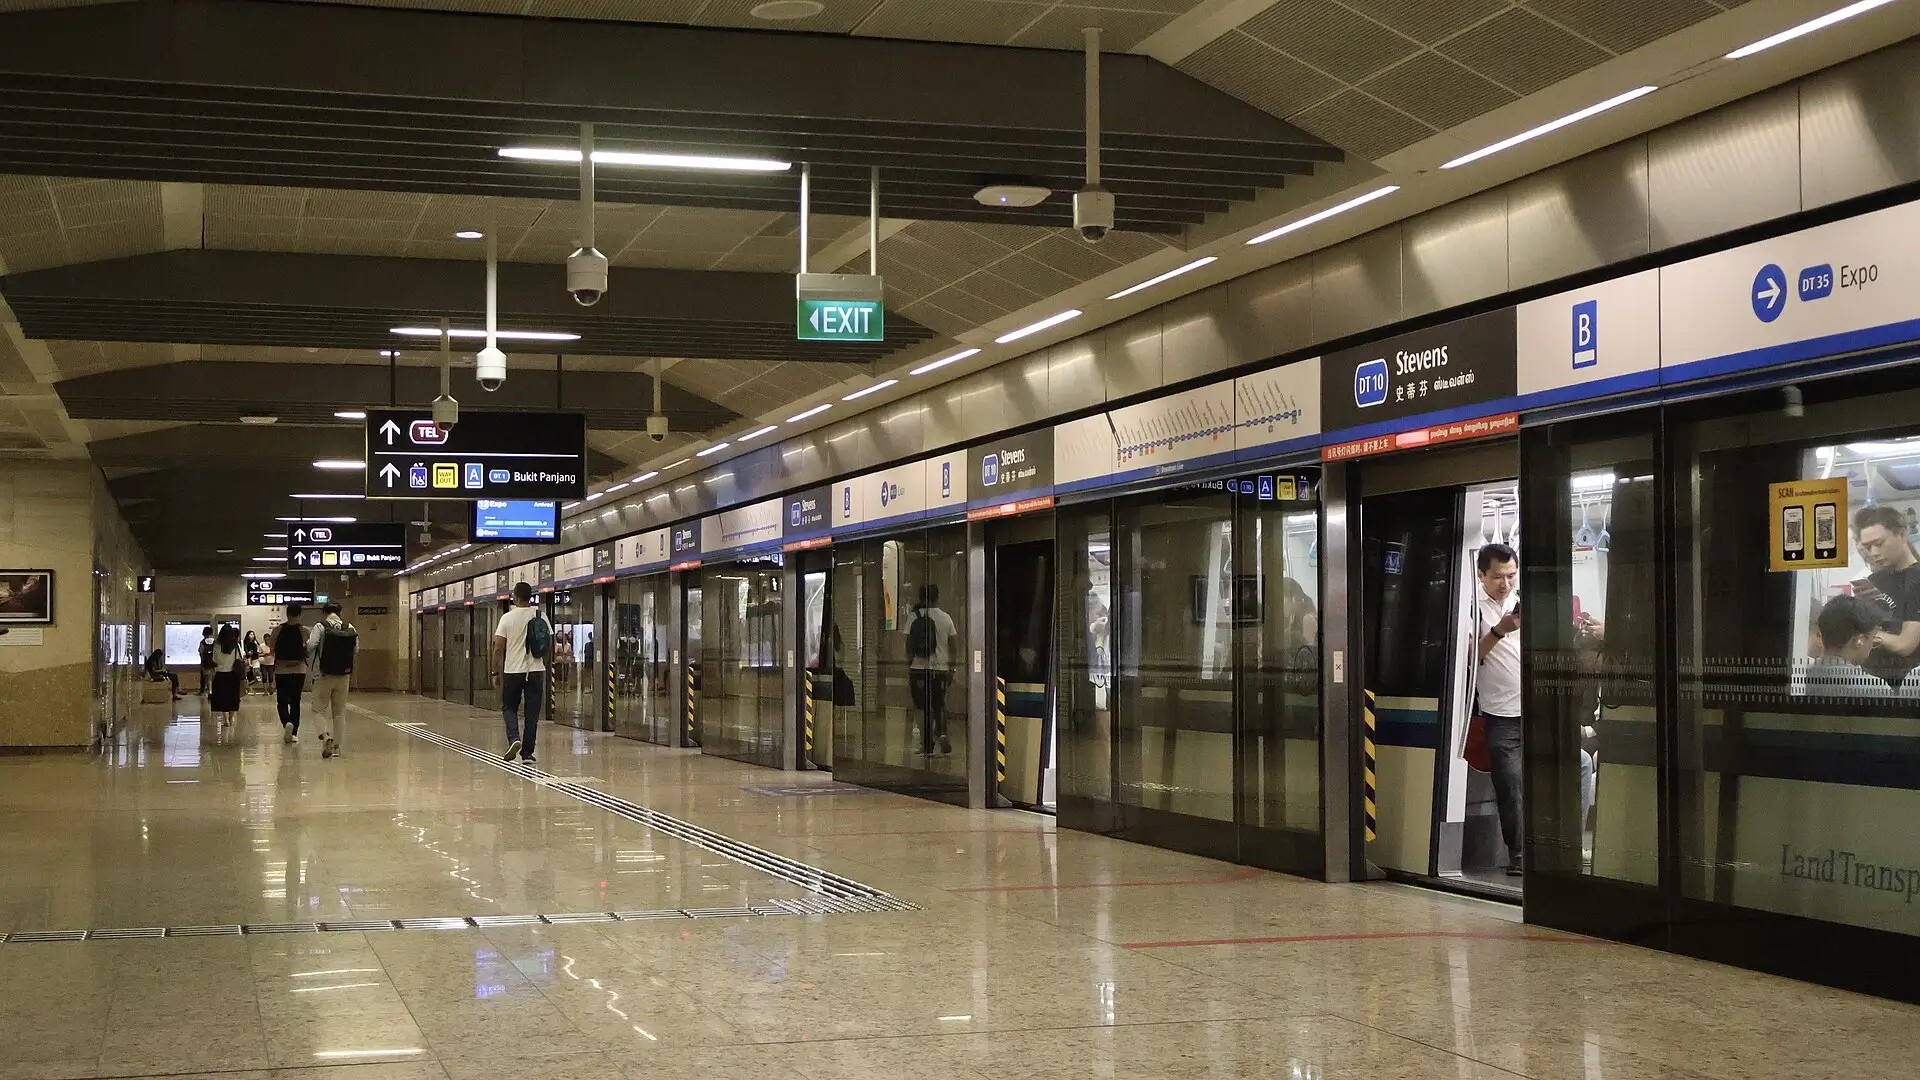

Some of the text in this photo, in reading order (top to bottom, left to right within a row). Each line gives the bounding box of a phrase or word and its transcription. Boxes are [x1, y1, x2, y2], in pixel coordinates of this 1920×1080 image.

[1802, 264, 1878, 292] DT 35 Expo
[823, 306, 873, 334] EXIT
[1579, 313, 1591, 347] B
[1395, 345, 1448, 376] Stevens
[1359, 373, 1384, 395] DT 10
[418, 426, 439, 438] TEL
[1001, 448, 1025, 467] Stevens
[470, 468, 479, 481] A
[514, 471, 538, 482] Bukit
[539, 471, 576, 484] Panjang
[315, 531, 327, 539] TEL
[1780, 843, 1835, 883] Land
